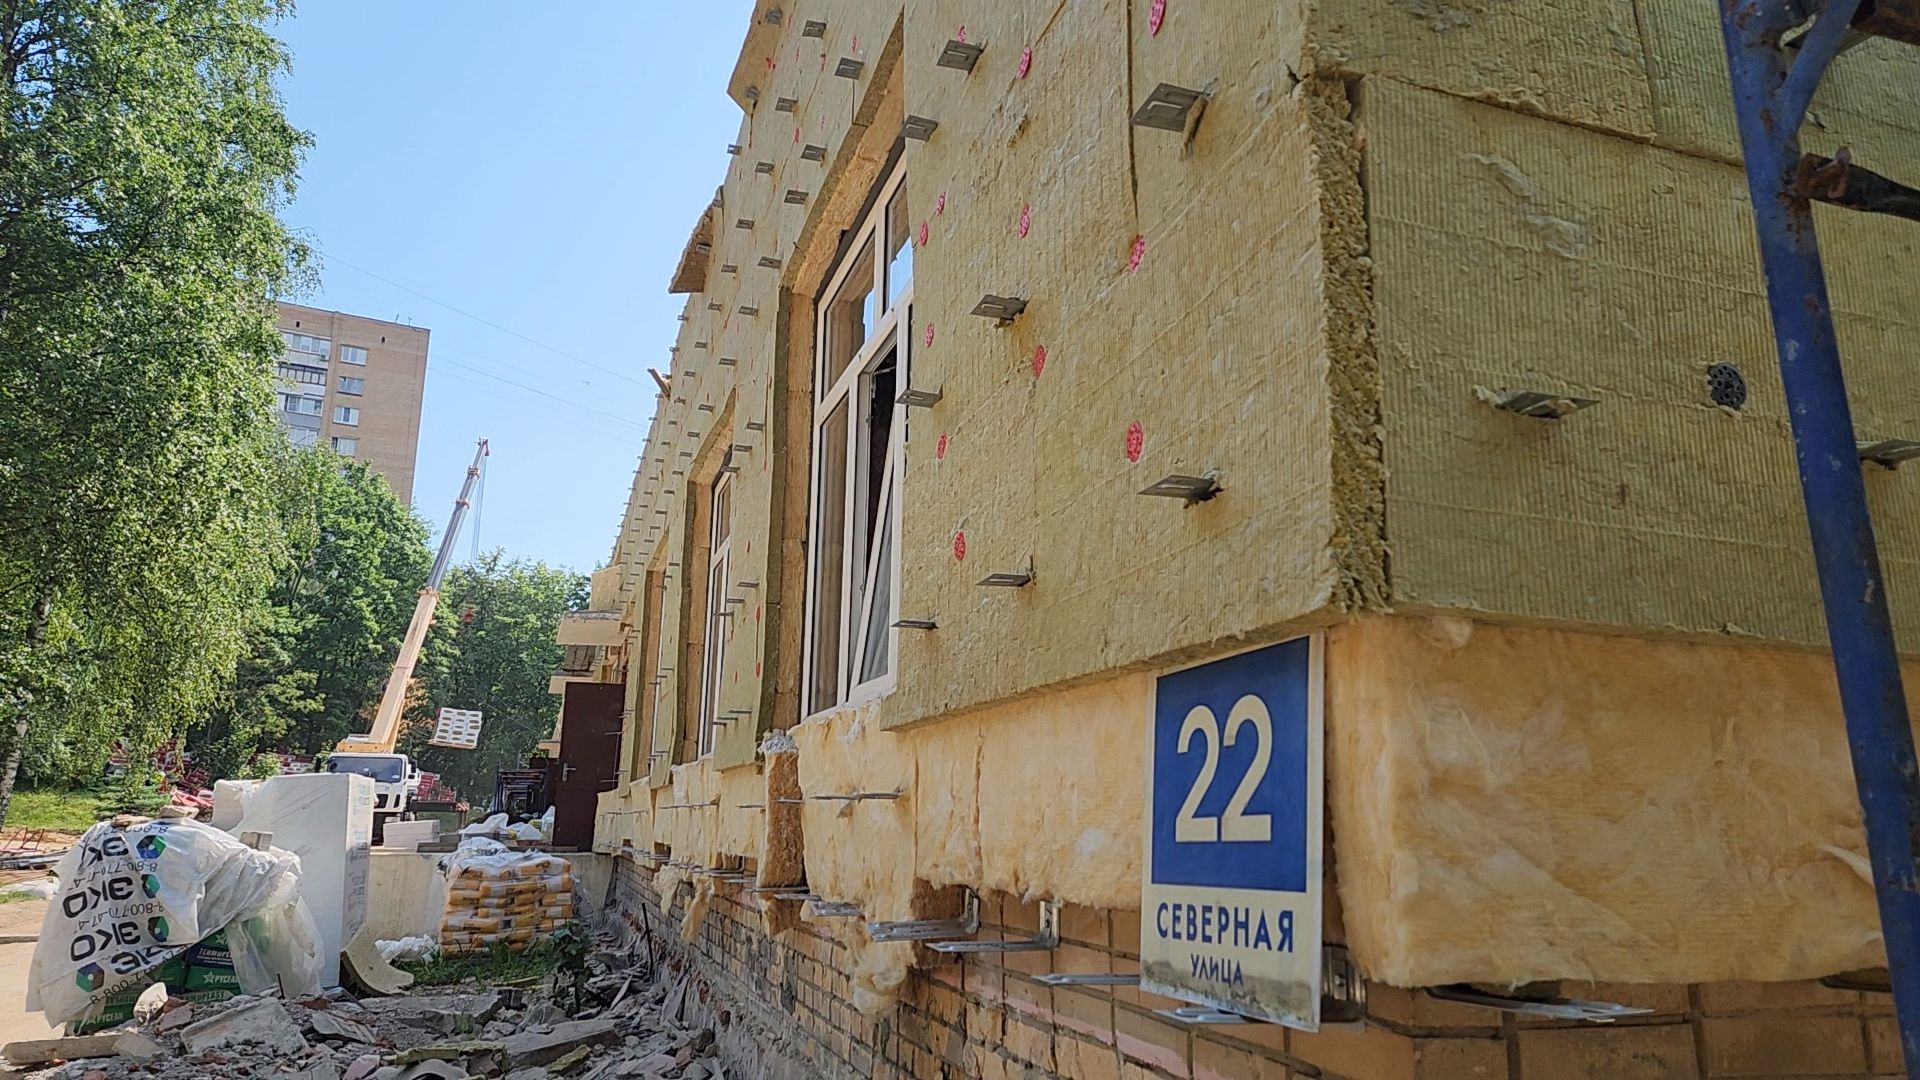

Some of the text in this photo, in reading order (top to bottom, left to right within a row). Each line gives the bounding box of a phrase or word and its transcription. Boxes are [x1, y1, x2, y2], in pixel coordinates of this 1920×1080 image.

[1175, 693, 1274, 843] 22
[62, 877, 134, 919] ЭКО
[70, 921, 141, 962] ЭКО
[1156, 902, 1294, 953] СЕВЕРНАЯ
[1190, 953, 1245, 987] УЛИЦА
